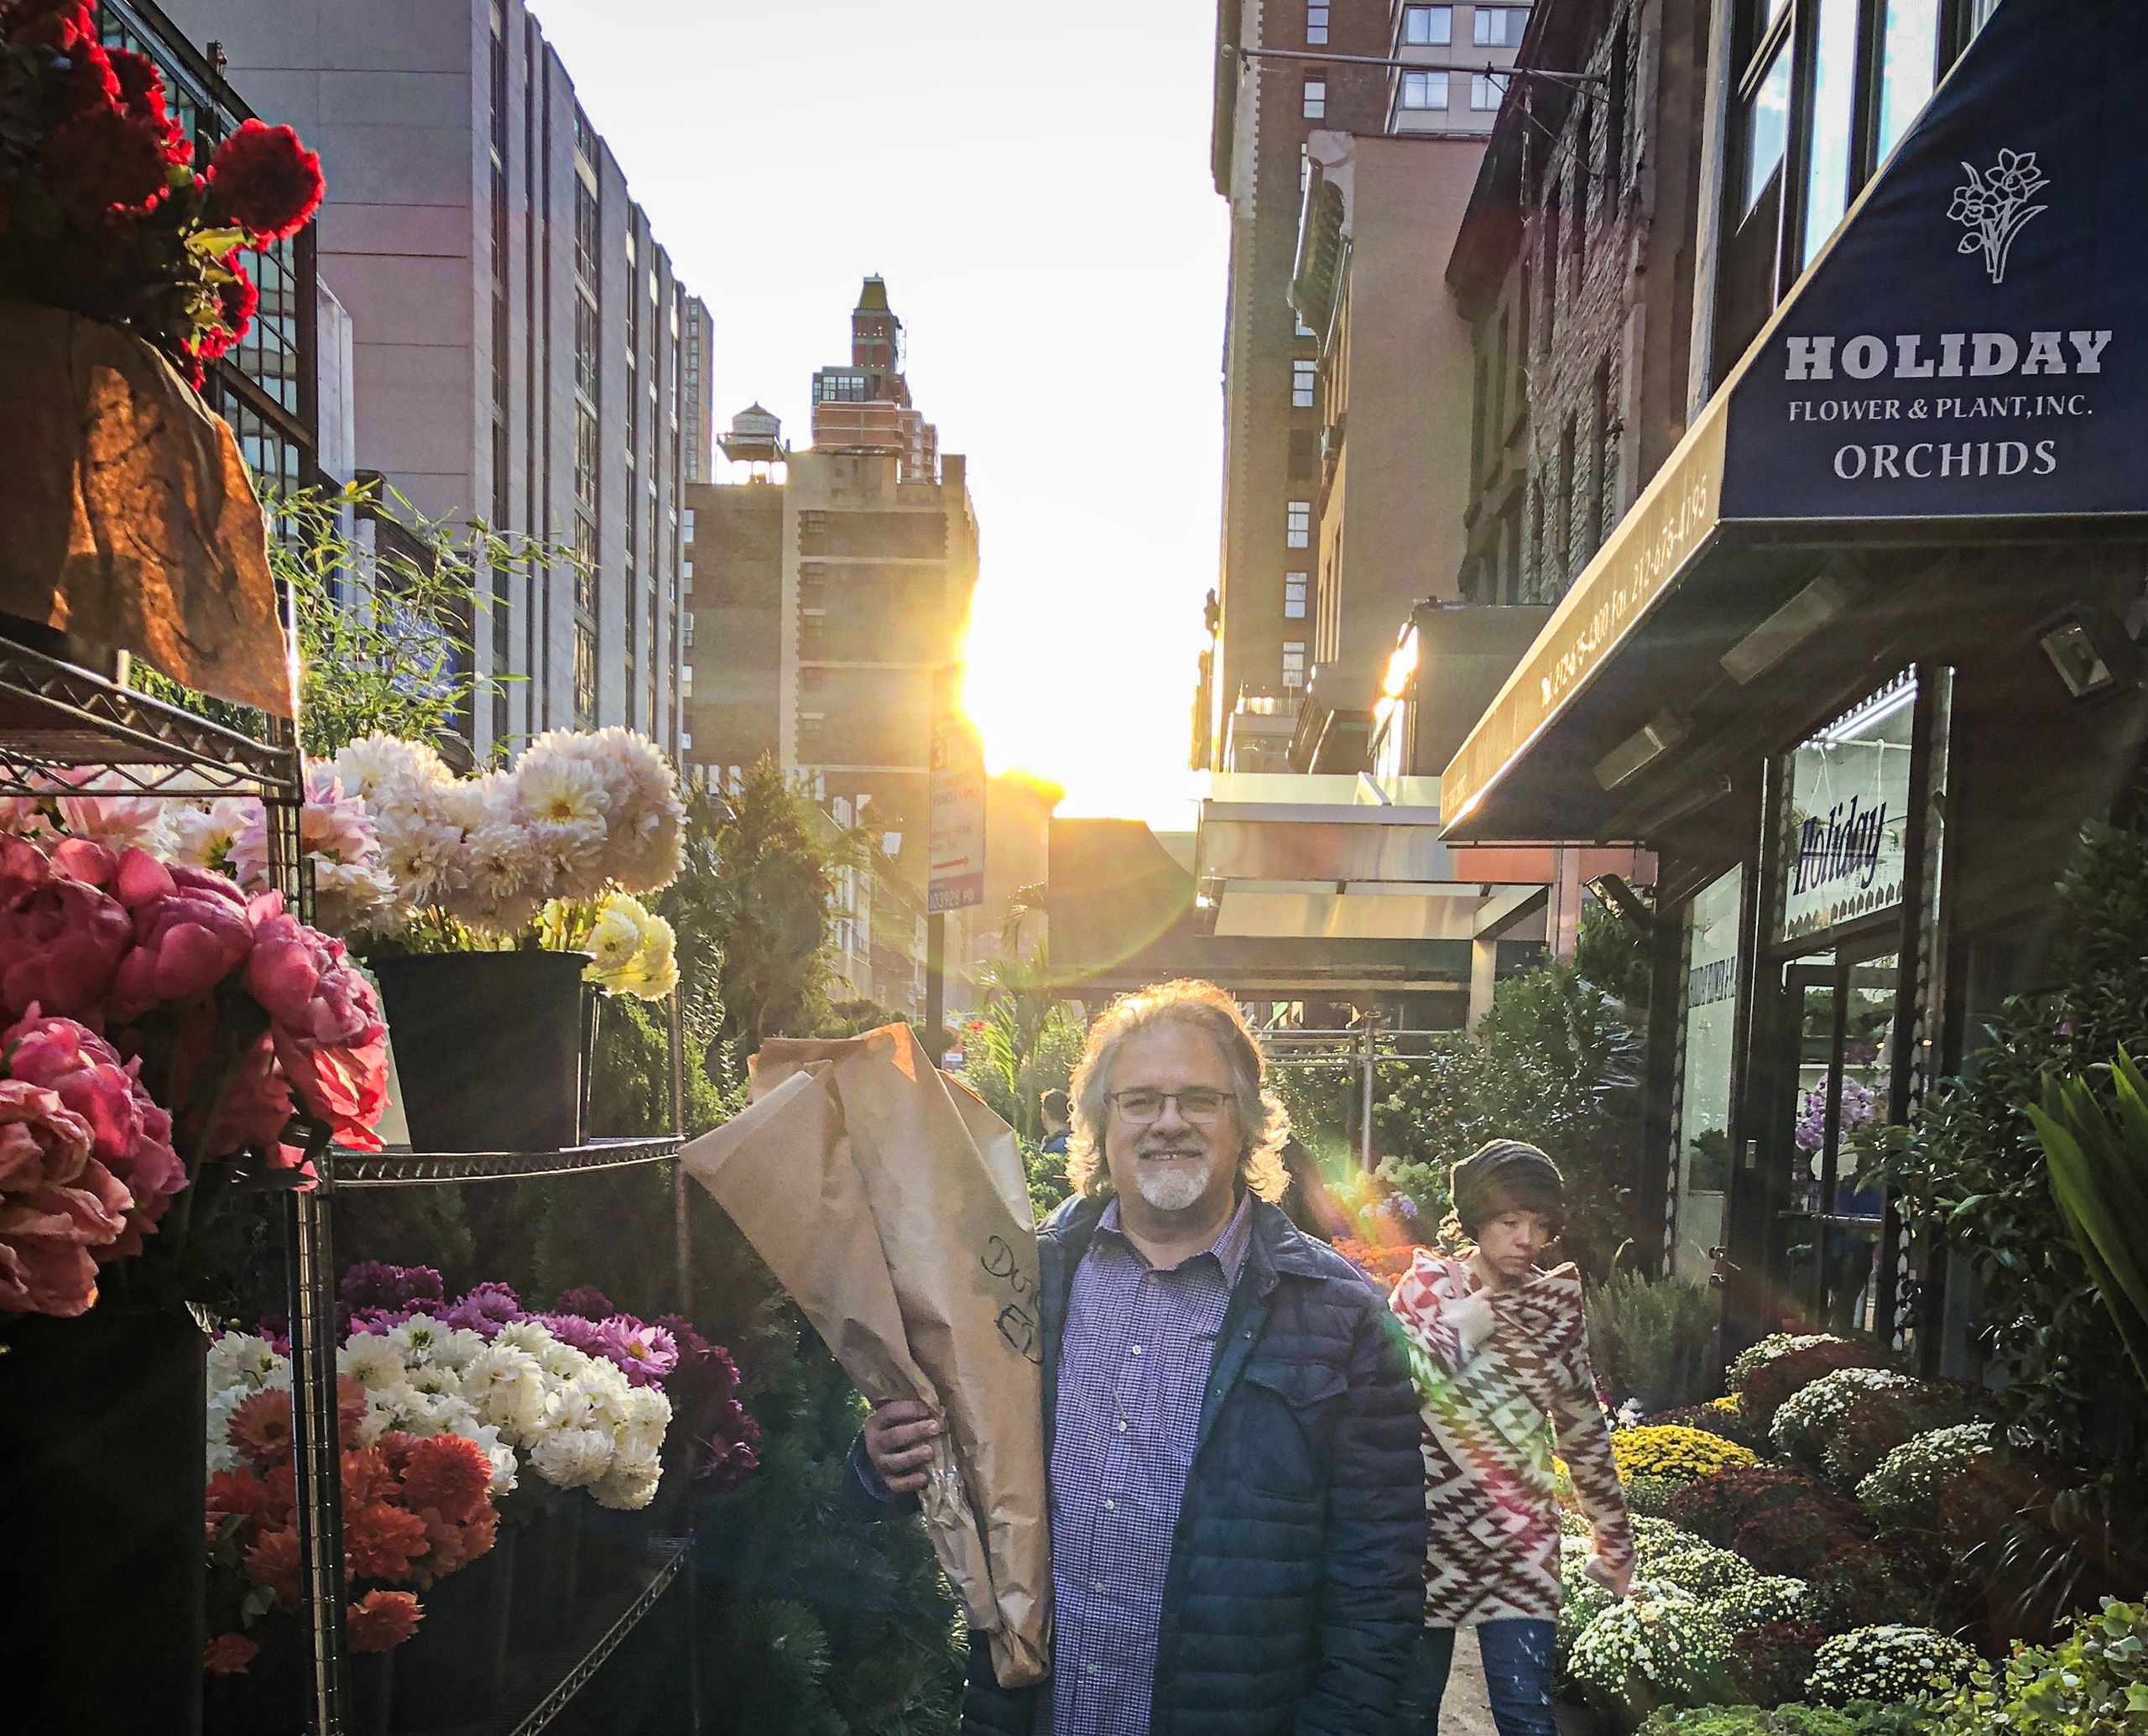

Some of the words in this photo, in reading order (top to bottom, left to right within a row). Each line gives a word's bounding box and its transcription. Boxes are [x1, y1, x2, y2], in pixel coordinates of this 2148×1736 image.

[1785, 331, 2113, 381] HOLIDAY
[1789, 399, 1900, 421] FLOWER
[1908, 399, 1928, 420] &
[1833, 440, 2057, 480] ORCHIDS
[1631, 473, 1707, 603] 212-675-4195
[1792, 794, 1888, 896] Holiday
